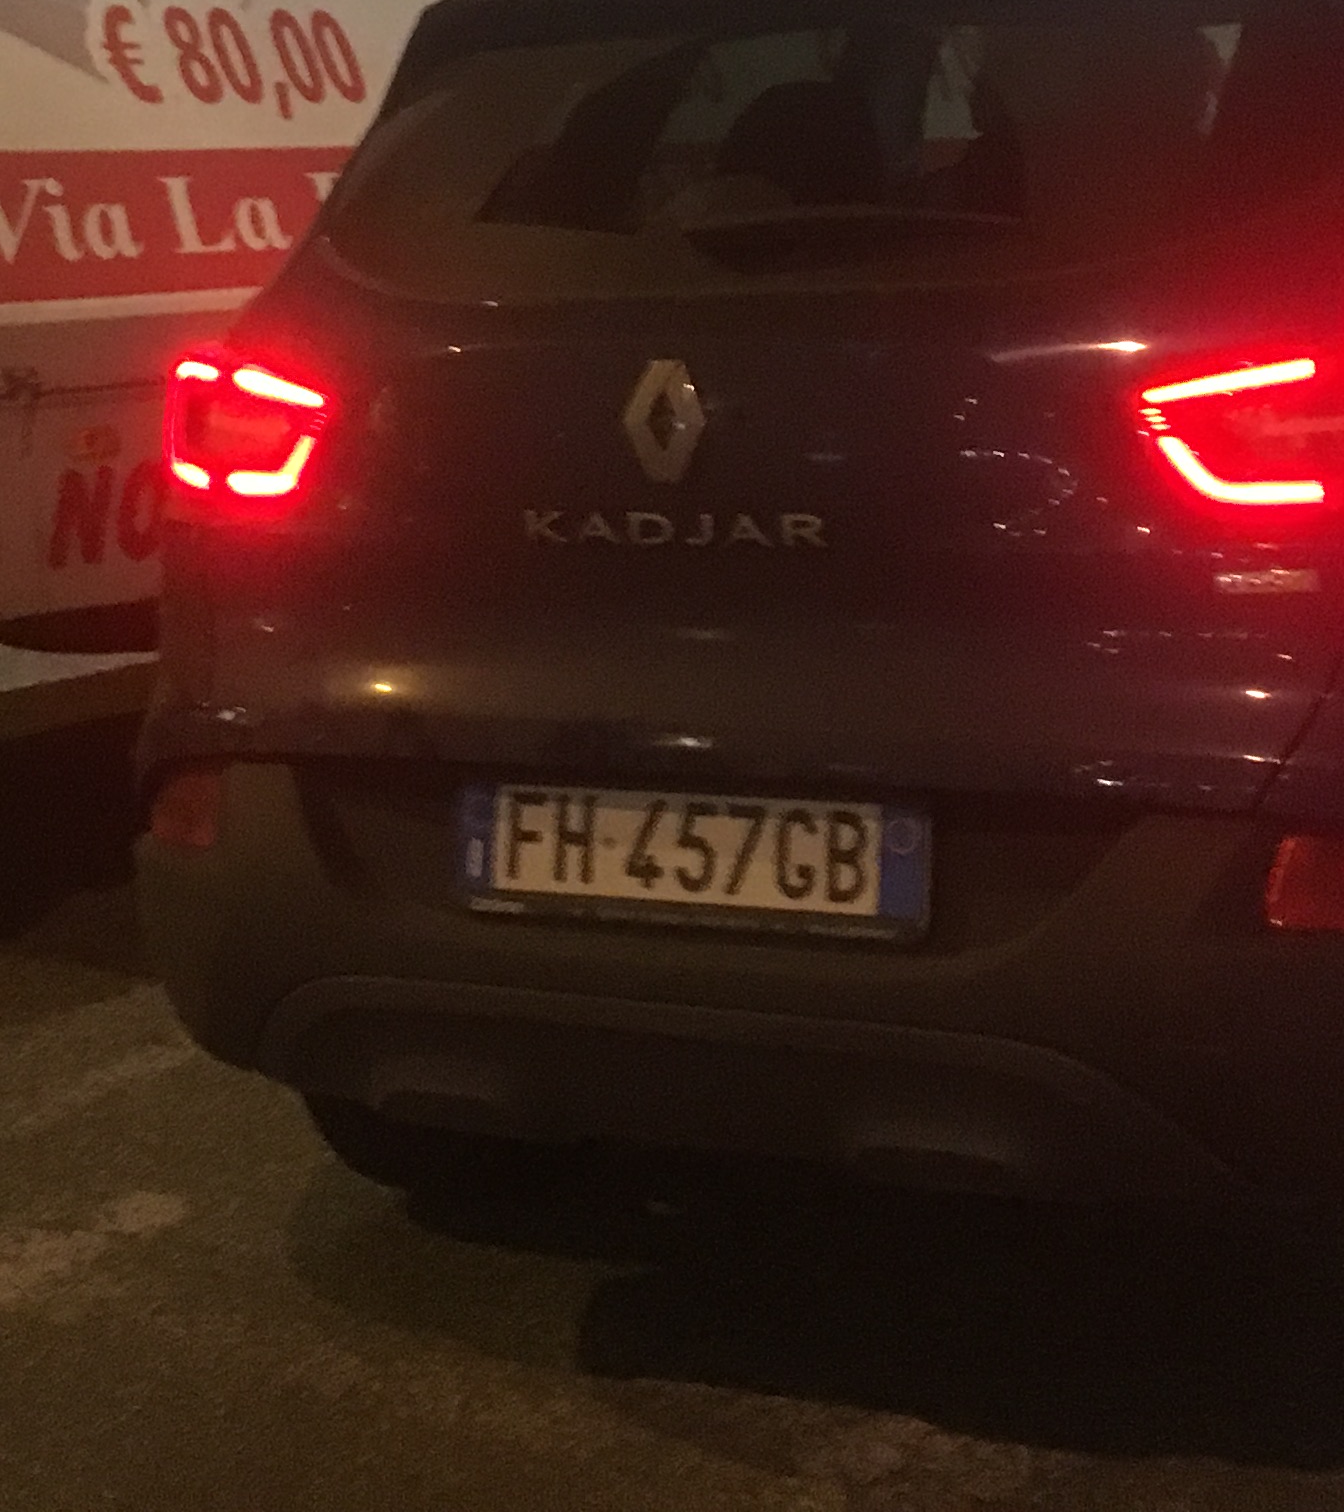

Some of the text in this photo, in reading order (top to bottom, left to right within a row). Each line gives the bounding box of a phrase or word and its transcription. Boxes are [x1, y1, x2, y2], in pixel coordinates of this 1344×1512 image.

[103, 5, 367, 119] € 80,00
[157, 174, 294, 256] La
[525, 507, 828, 548] KADJAR
[506, 792, 871, 903] FH 457GB
